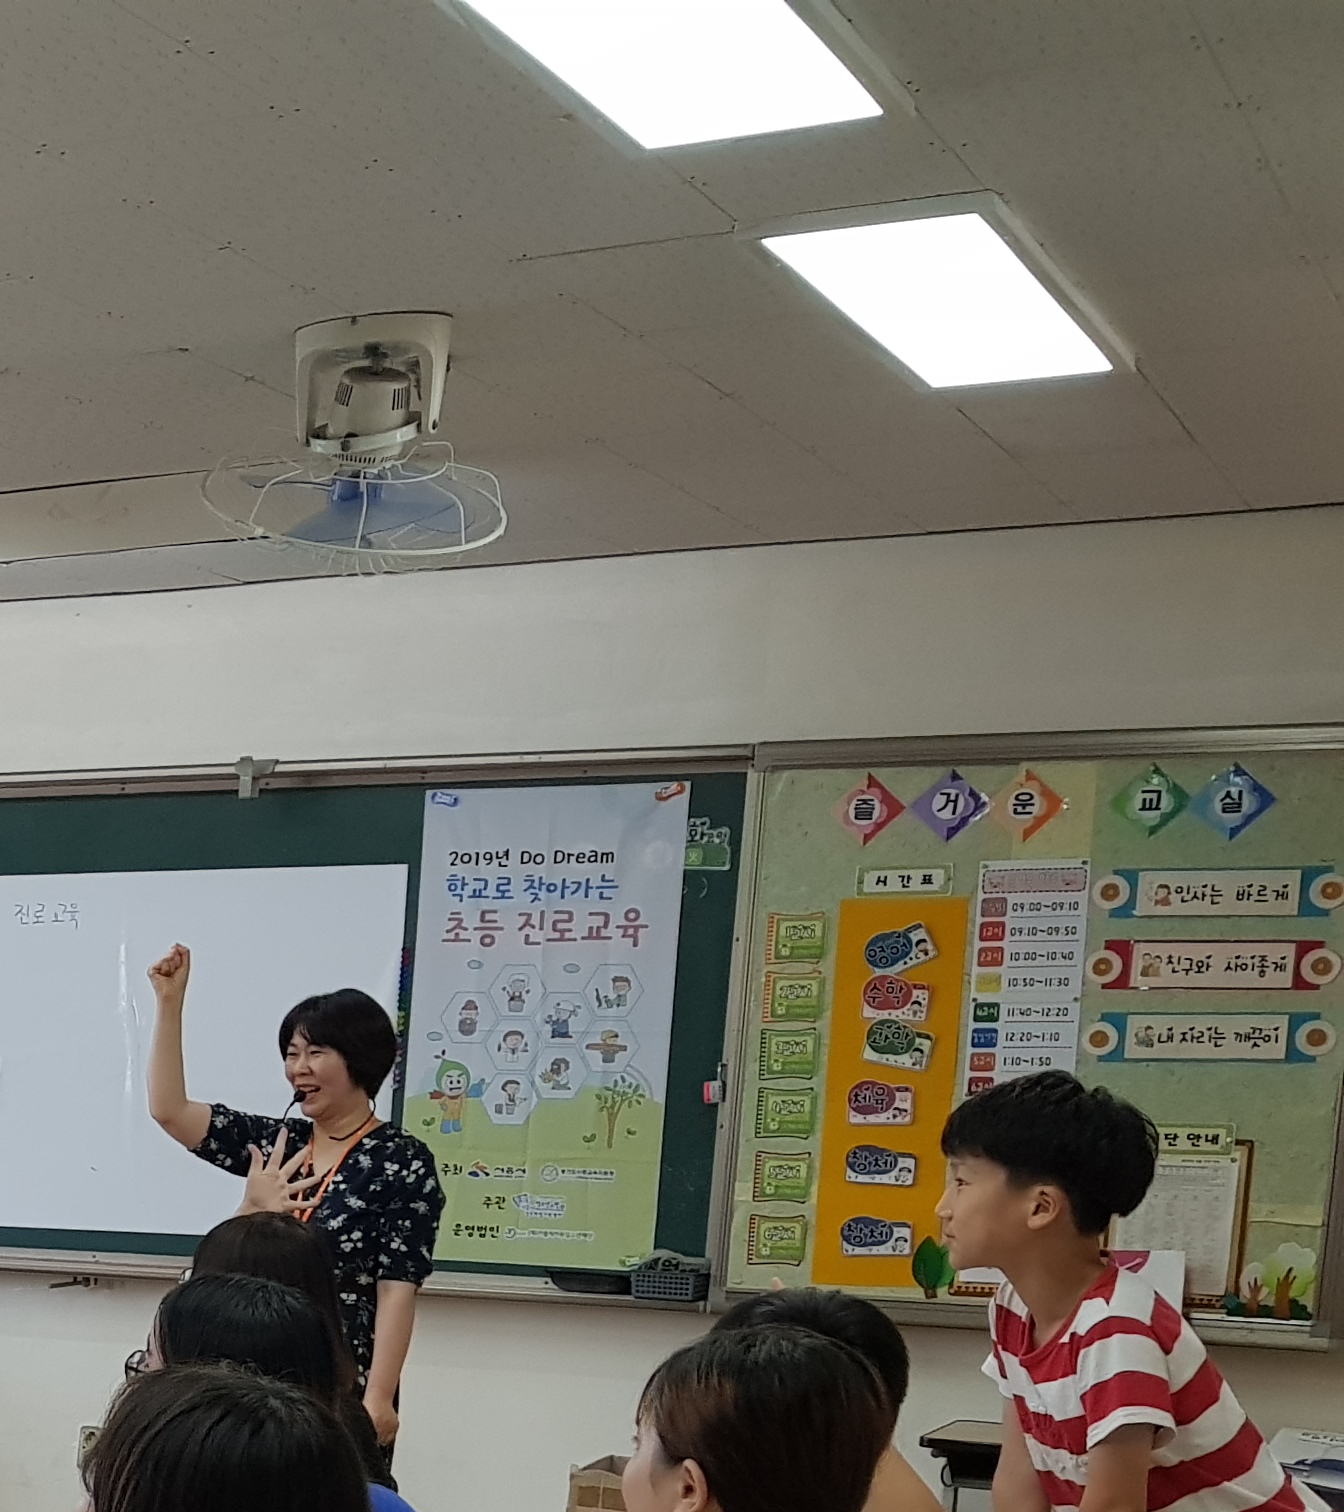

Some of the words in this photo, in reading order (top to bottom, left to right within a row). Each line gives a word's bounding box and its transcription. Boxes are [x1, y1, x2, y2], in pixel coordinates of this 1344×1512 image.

[449, 849, 510, 868] 2019년
[520, 850, 545, 865] Do
[553, 849, 614, 865] Dream
[446, 874, 515, 903] 학교로
[523, 874, 619, 903] 찾아가는
[875, 874, 933, 888] 시간표
[1175, 883, 1224, 905] 인사는
[1236, 883, 1289, 903] 바르게
[14, 903, 80, 930] 진로교육
[441, 909, 505, 948] 초등
[517, 907, 649, 948] 진로교육
[867, 931, 909, 966] 영어
[1166, 954, 1212, 977] 친구와
[1224, 954, 1287, 978] 사이좋게
[867, 979, 906, 1006] 수학
[1157, 1026, 1174, 1044] 내
[1179, 1026, 1226, 1048] 자리는
[1234, 1026, 1280, 1049] 깨끗이
[852, 1085, 887, 1112] 체육
[1187, 1133, 1220, 1147] 안내
[441, 1163, 463, 1176] 주최
[483, 1196, 506, 1210] 주관
[453, 1223, 500, 1239] 운영법인
